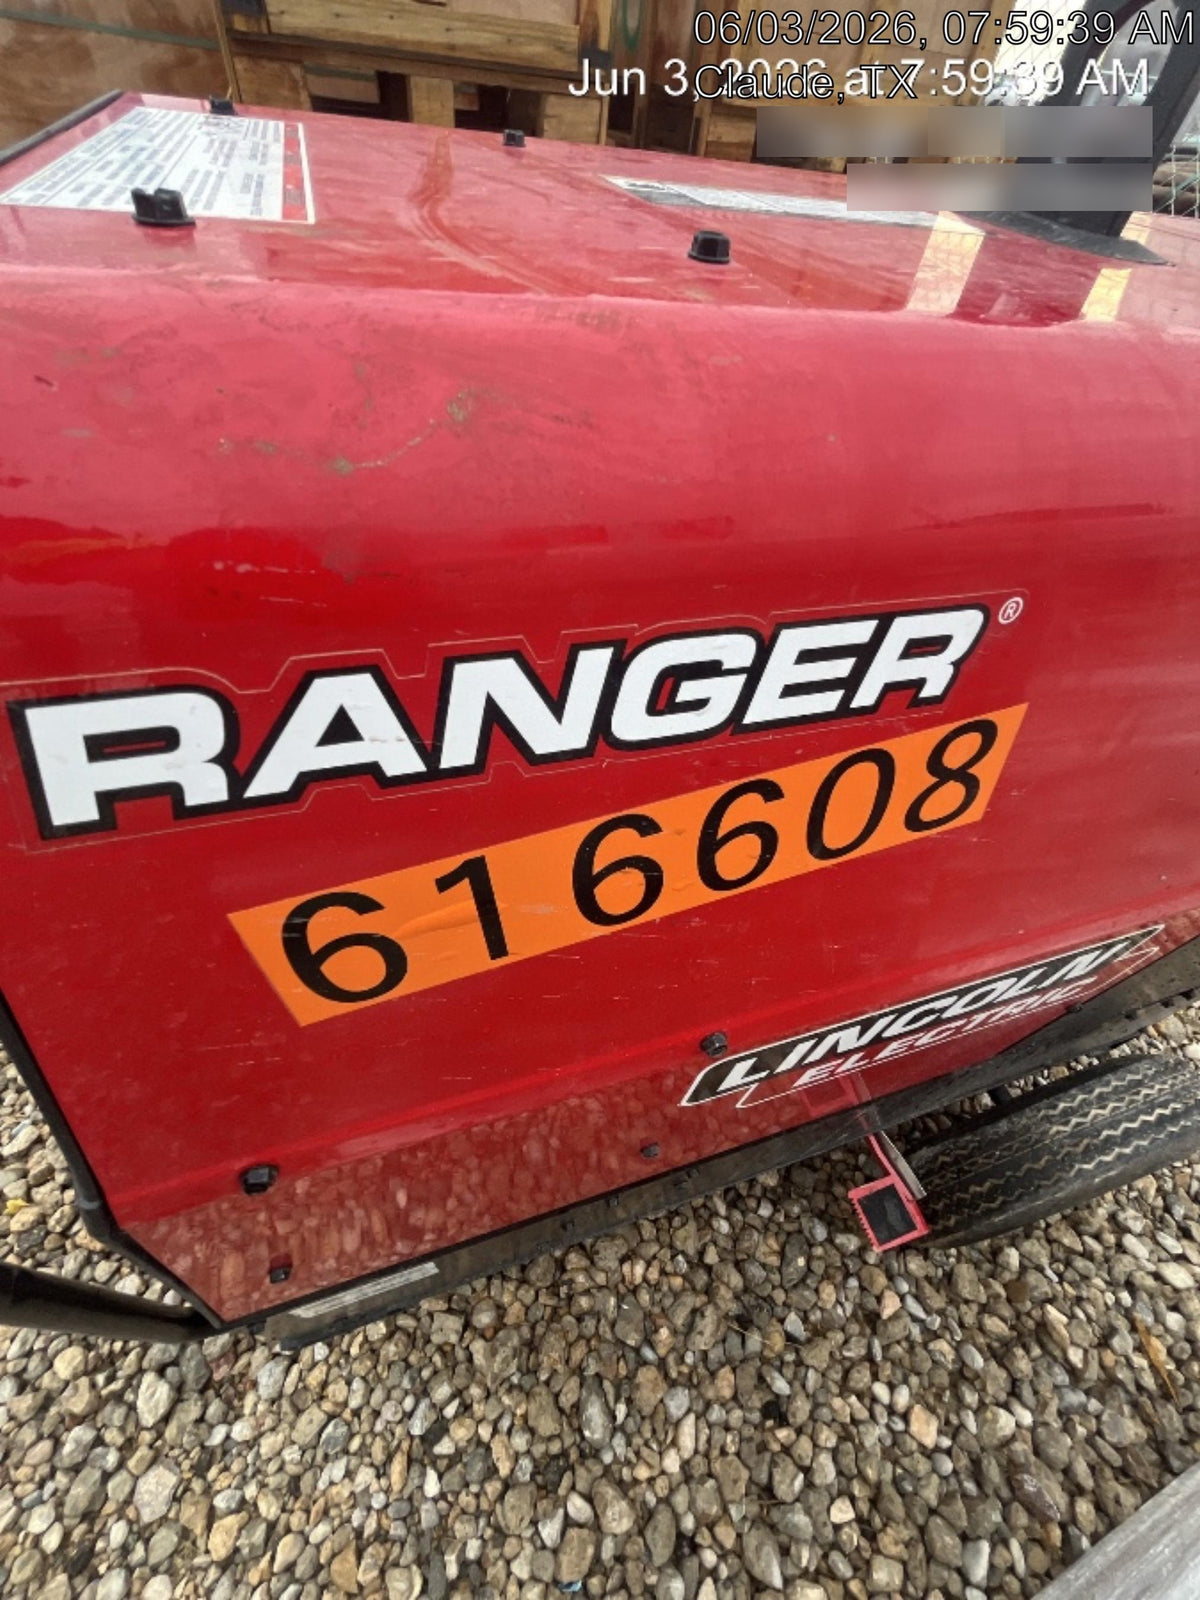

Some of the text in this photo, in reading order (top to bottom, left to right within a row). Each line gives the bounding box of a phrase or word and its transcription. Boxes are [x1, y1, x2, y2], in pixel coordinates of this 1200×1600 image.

[24, 607, 986, 828] RANGER
[280, 718, 998, 1003] 616608
[716, 942, 1132, 1092] LINCOLN
[793, 976, 1099, 1087] ELECTRIC
